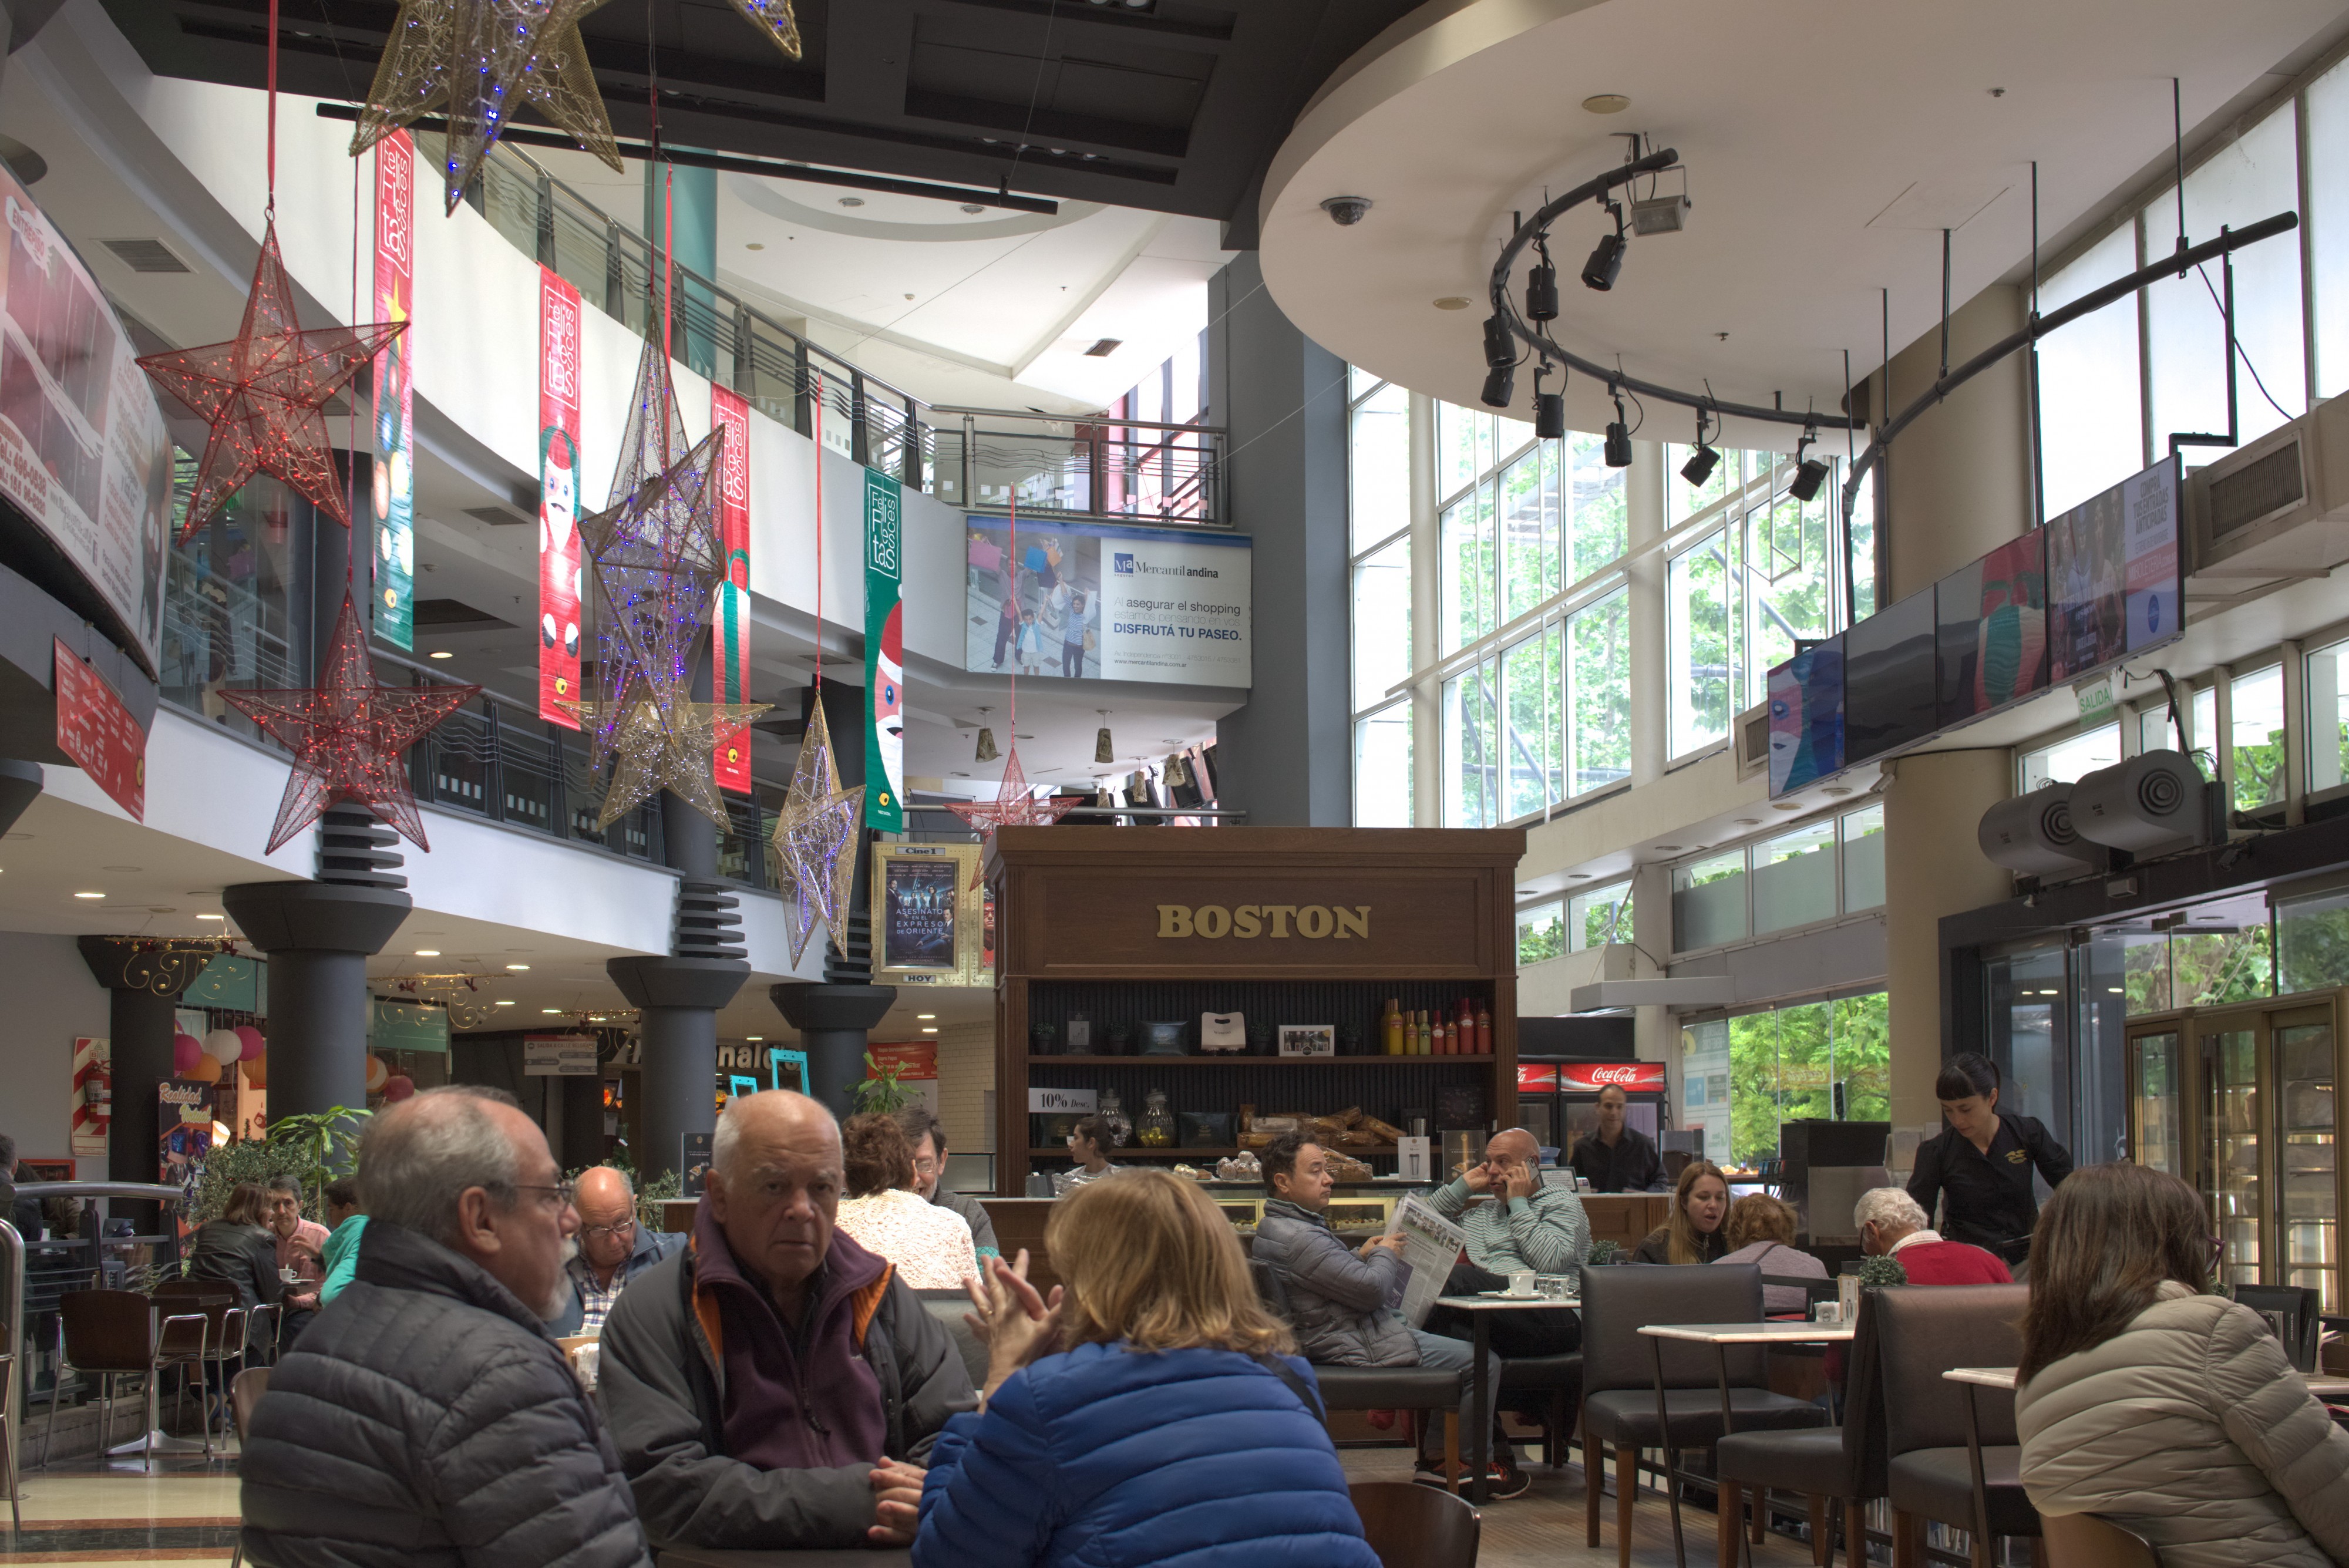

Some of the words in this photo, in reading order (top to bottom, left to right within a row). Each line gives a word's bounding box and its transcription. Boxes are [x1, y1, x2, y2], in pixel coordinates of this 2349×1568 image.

[12, 207, 45, 257] ENTREPISO
[2140, 469, 2160, 499] COMPRÁ
[2133, 500, 2143, 519] TUS
[2143, 486, 2168, 514] ENTRADAS
[2135, 506, 2167, 536] ANTICIPADAS
[1135, 561, 1185, 576] Mercantil
[1187, 568, 1219, 578] andina
[1114, 597, 1123, 606] Al
[1126, 599, 1174, 611] asegurar
[1178, 601, 1186, 610] el
[1190, 602, 1240, 617] shopping
[1115, 611, 1155, 621] estamos
[1159, 614, 1206, 625] pensando
[1209, 617, 1220, 625] en
[1224, 618, 1242, 627] vos.
[1114, 623, 1174, 637] DISFRUTÁ
[1178, 627, 1194, 638] TU
[1199, 628, 1242, 641] PASEO.
[1115, 659, 1187, 668] www.mercantilandina.com.ar
[2079, 688, 2110, 713] SALIDA
[1156, 905, 1371, 938] BOSTON
[1591, 1067, 1638, 1082] Coca-Cola
[160, 1082, 202, 1105] Realidad
[1041, 1093, 1068, 1108] 10%
[1071, 1099, 1089, 1108] Desc.
[179, 1103, 212, 1123] Virtual
